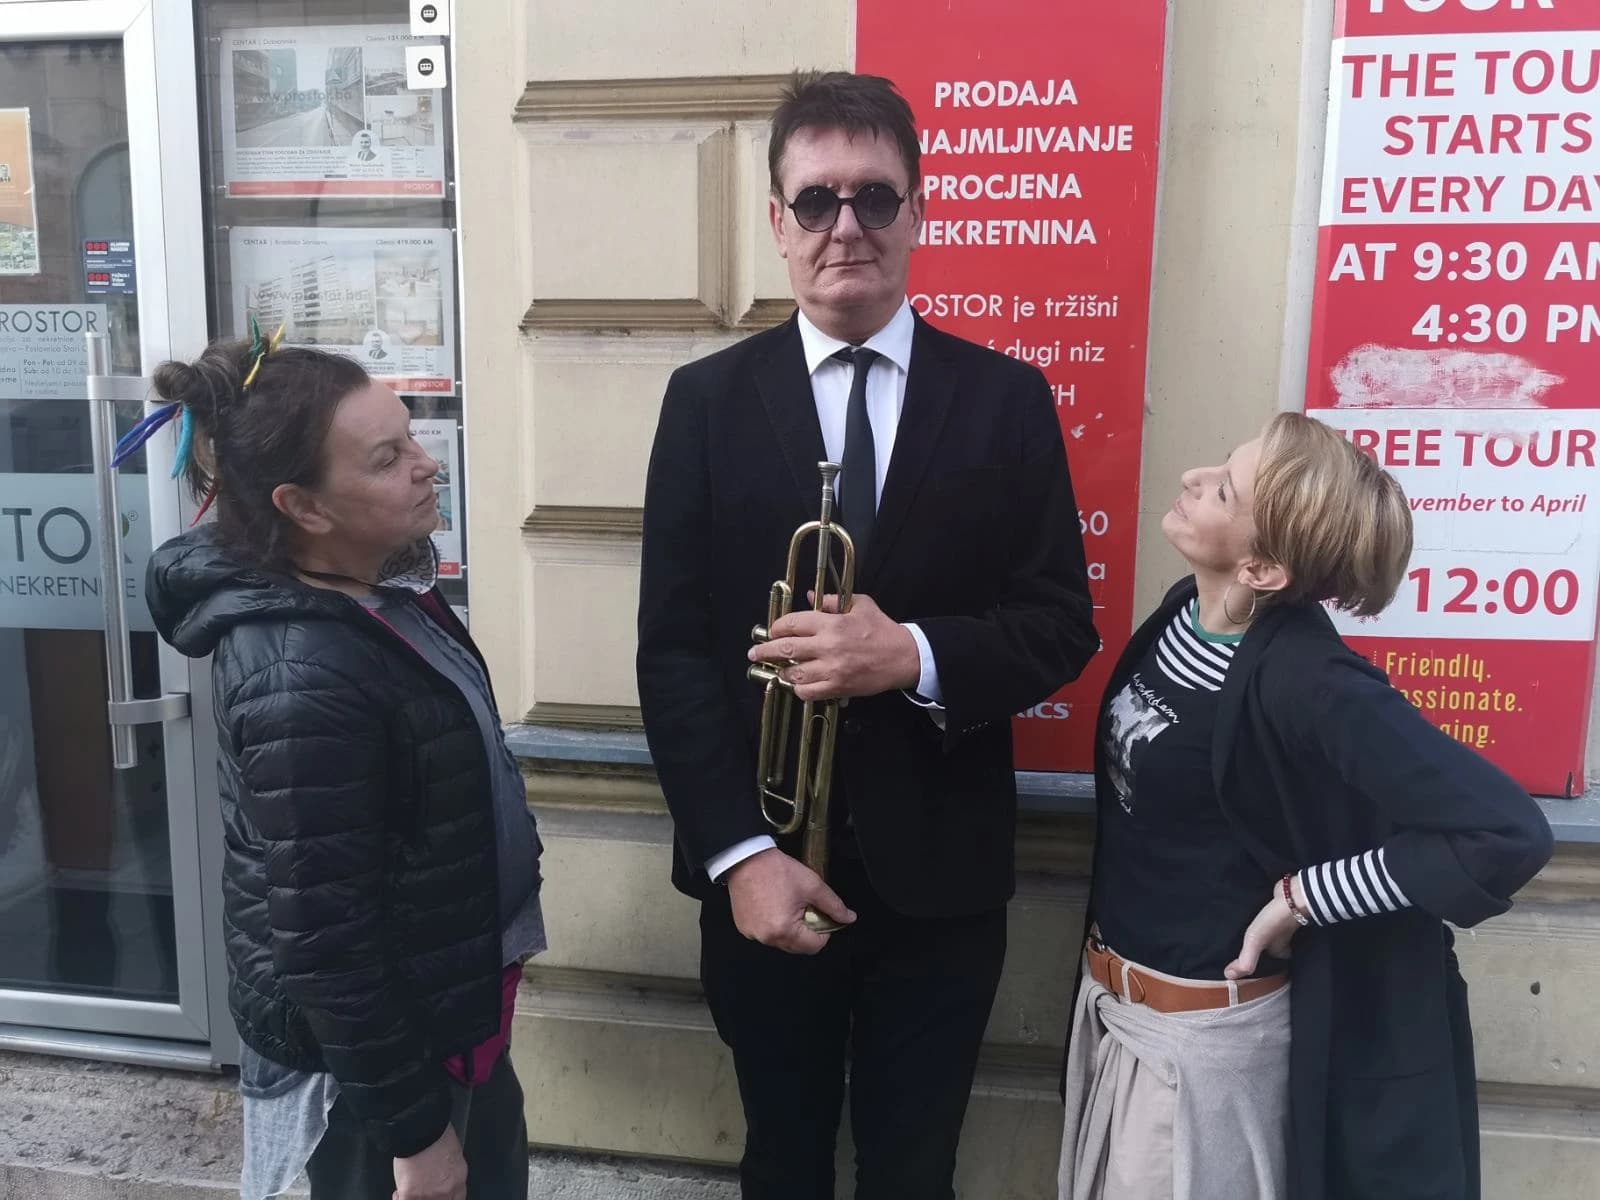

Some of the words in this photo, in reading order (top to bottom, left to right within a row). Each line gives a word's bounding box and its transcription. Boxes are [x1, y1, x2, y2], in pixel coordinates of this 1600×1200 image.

[934, 80, 1078, 108] PRODAJA
[1342, 52, 1457, 98] THE
[1382, 112, 1592, 156] STARTS
[923, 173, 1082, 201] PROCJENA
[1341, 176, 1506, 213] EVERY
[1523, 175, 1600, 212] DA
[1328, 243, 1397, 281] AT
[1413, 241, 1528, 281] 9:30
[1013, 295, 1035, 322] je
[1045, 295, 1119, 317] tržišni
[1411, 304, 1528, 343] 4:30
[1004, 339, 1061, 367] dugi
[1069, 341, 1105, 362] niz
[1336, 429, 1441, 467] REE
[1455, 430, 1597, 467] TOUR
[1409, 493, 1496, 513] vember
[1502, 495, 1525, 512] to
[1530, 494, 1587, 517] April
[1408, 567, 1580, 615] 12:00
[1385, 652, 1492, 683] Friendly.
